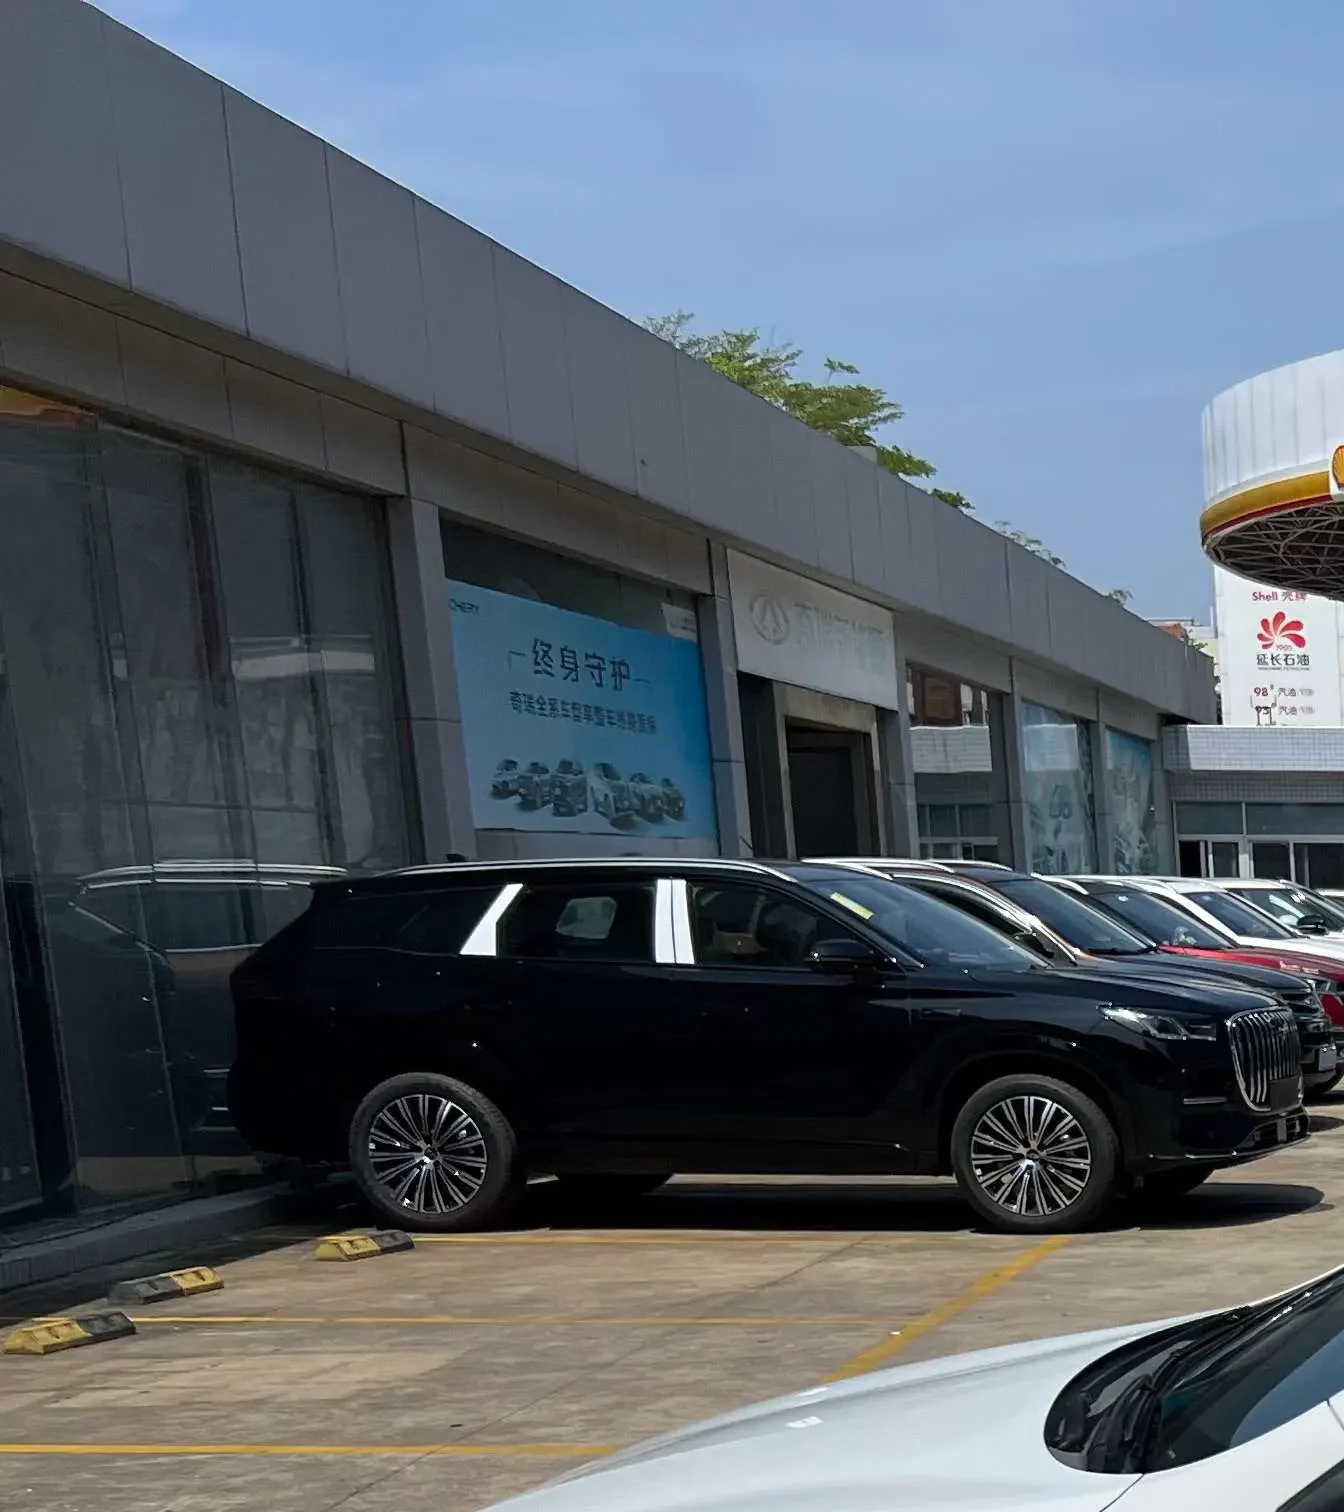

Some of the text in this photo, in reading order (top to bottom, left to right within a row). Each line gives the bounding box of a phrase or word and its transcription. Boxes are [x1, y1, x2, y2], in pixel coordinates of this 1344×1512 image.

[1252, 591, 1278, 601] Shell
[532, 637, 631, 691] 终身守护
[1256, 653, 1310, 666] 延长石油
